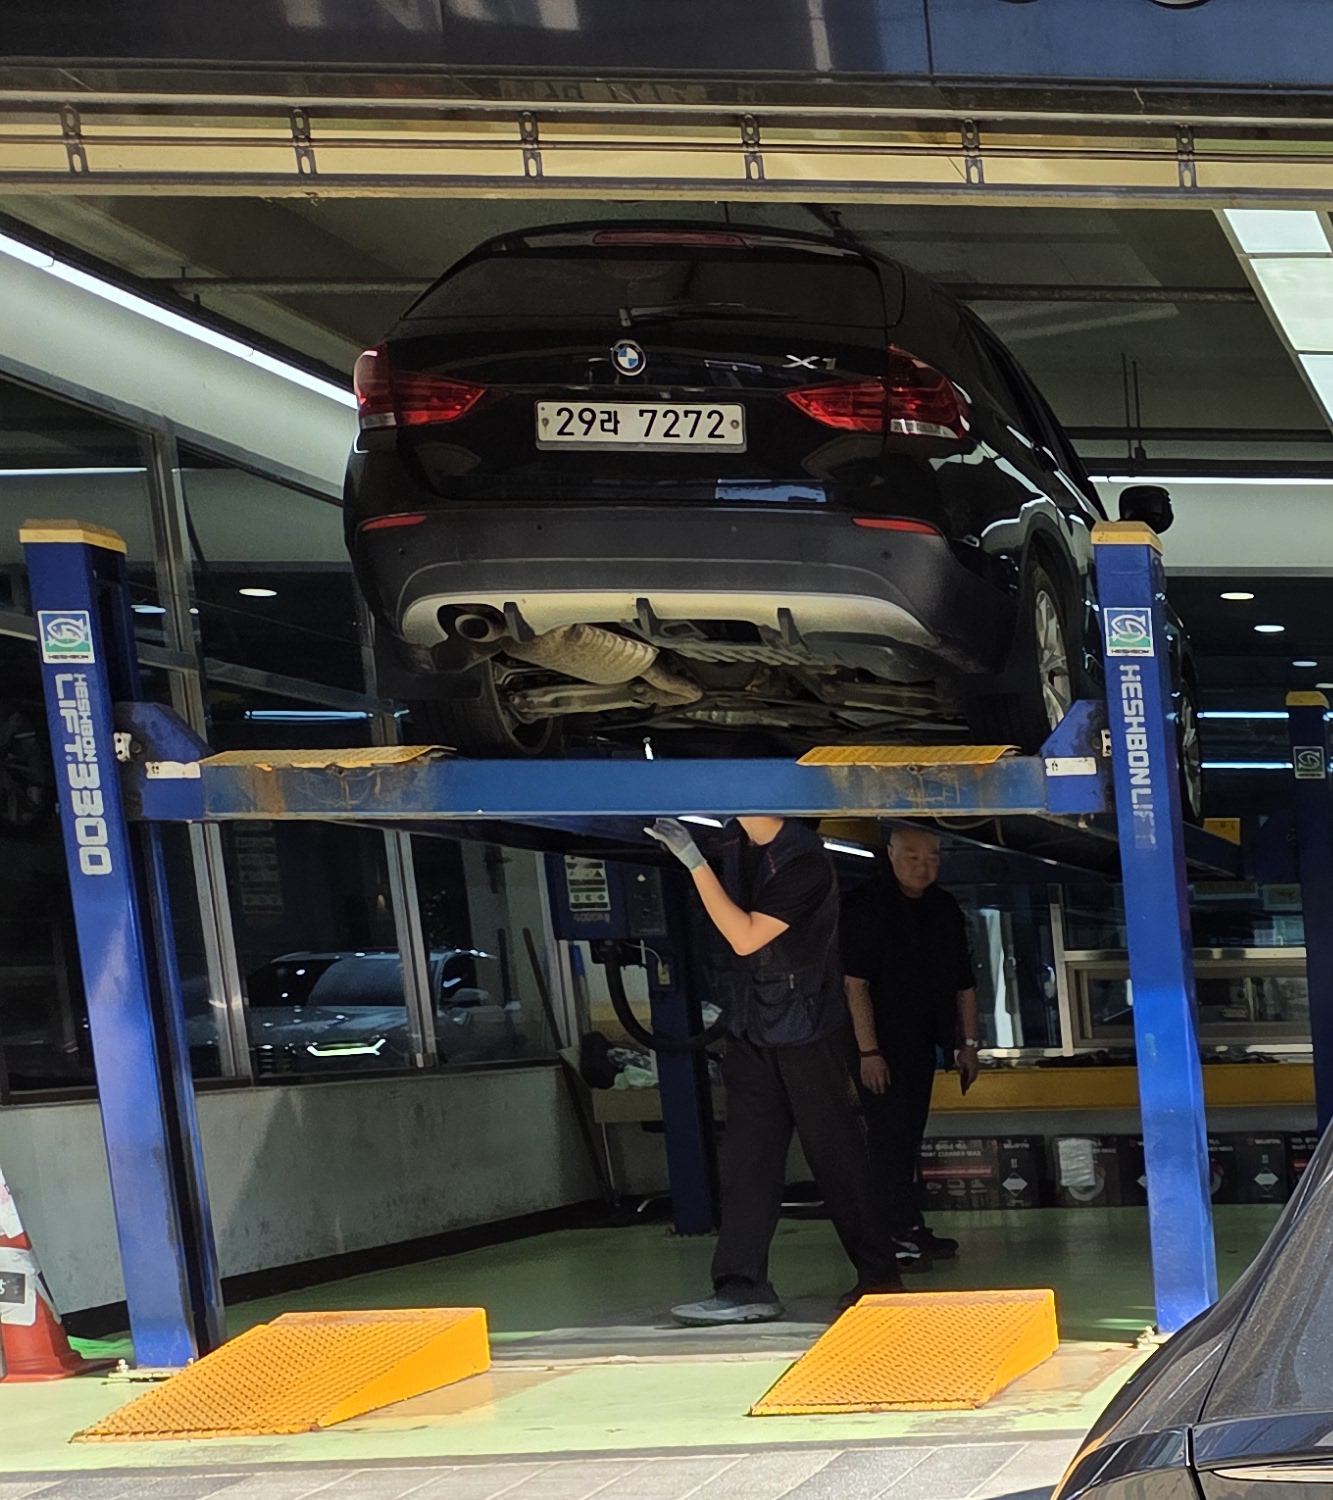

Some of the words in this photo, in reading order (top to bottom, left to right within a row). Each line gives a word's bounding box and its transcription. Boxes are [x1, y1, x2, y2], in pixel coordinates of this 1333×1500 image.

[555, 407, 621, 436] 29라
[638, 409, 726, 439] 7272
[73, 673, 98, 762] HESHBON
